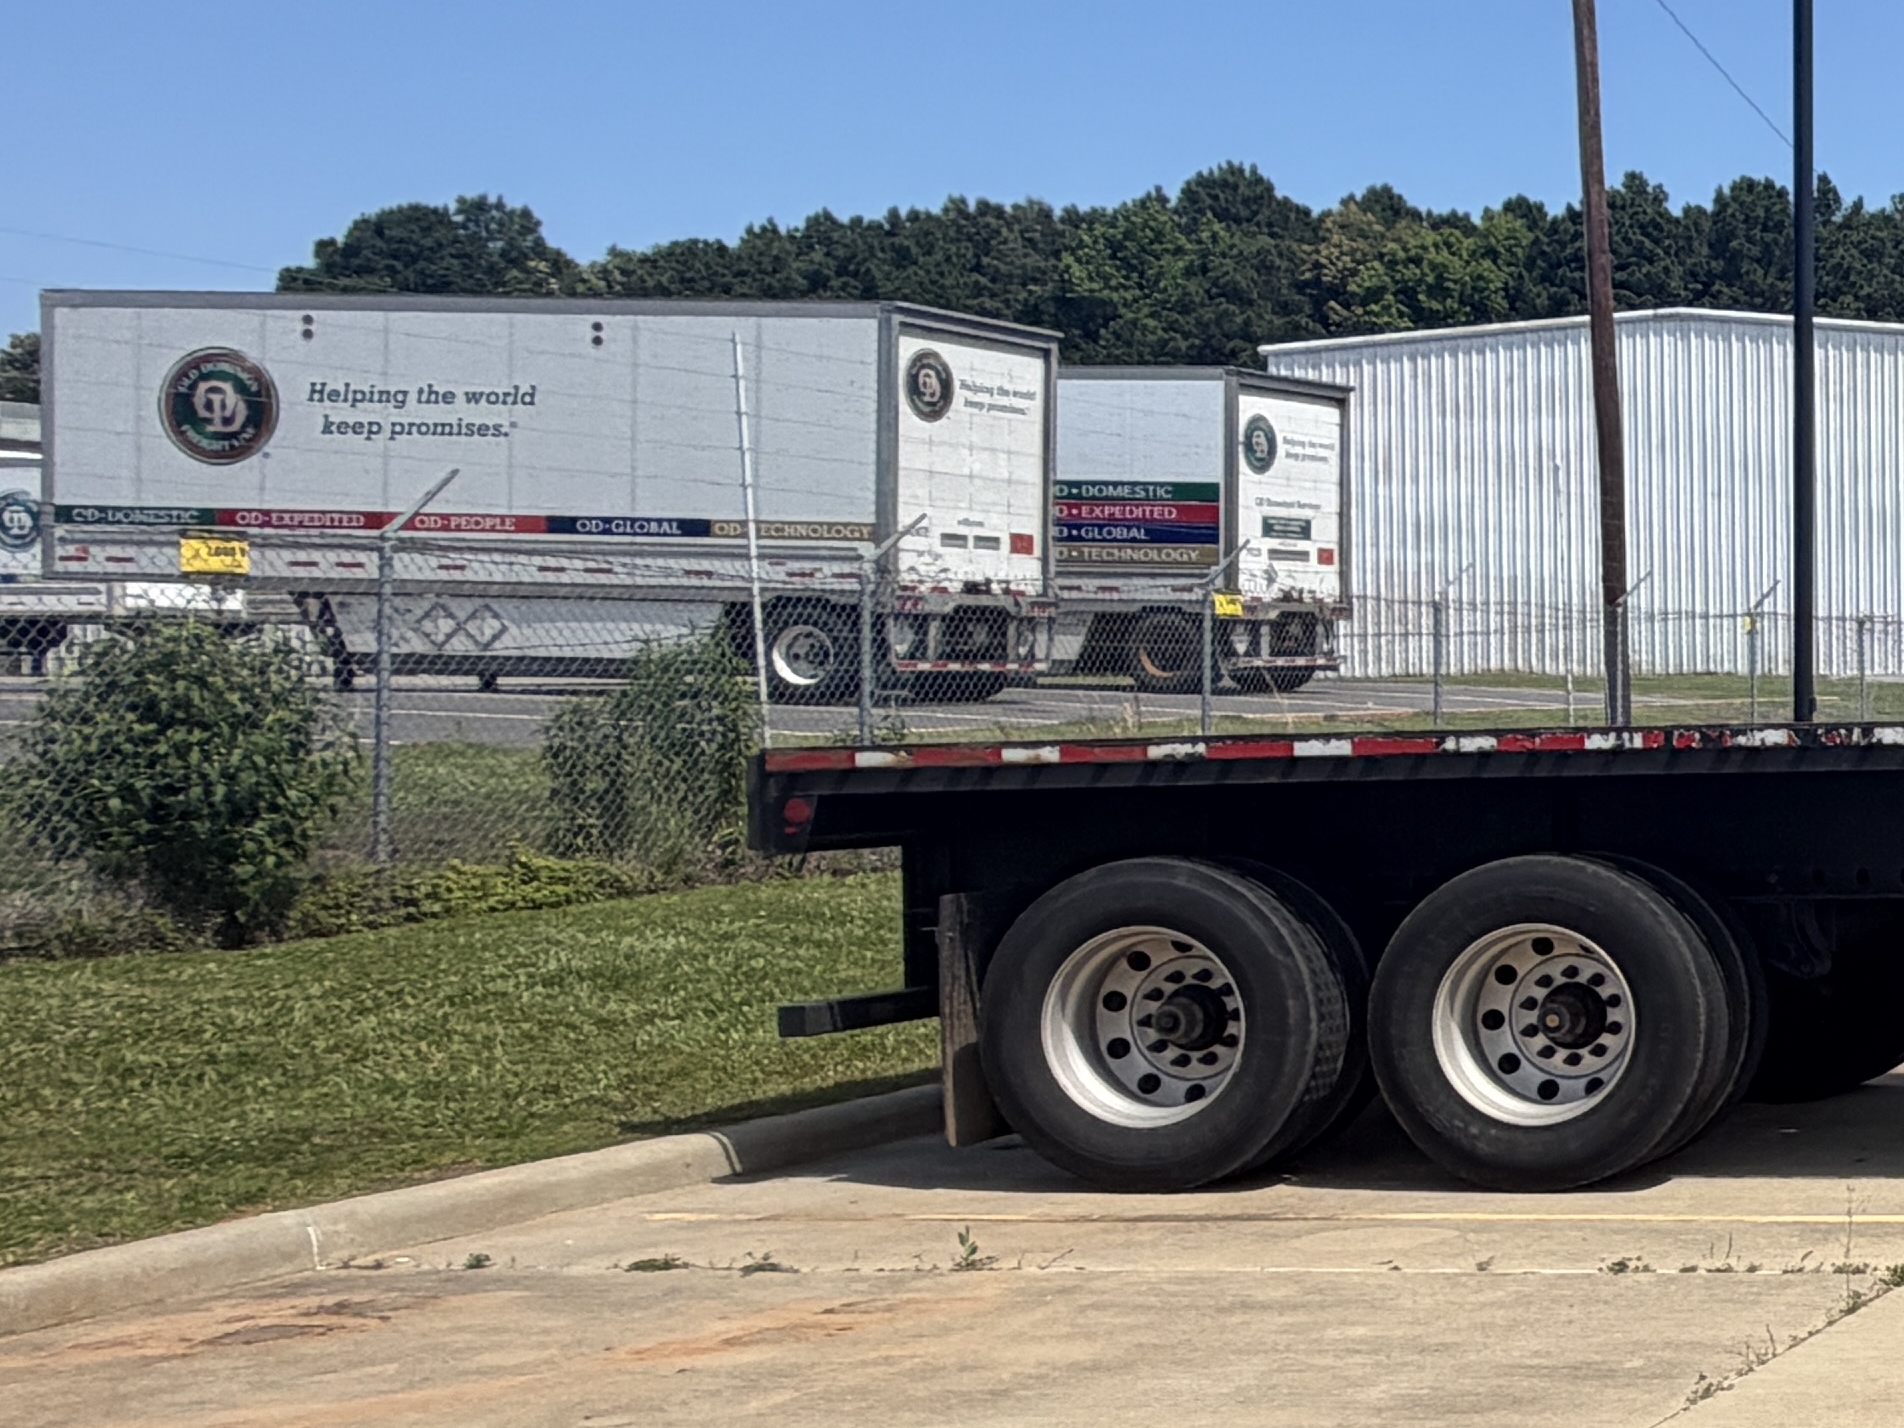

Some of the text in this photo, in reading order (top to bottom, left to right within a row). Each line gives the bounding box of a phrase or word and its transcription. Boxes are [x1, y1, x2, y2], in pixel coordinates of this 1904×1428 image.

[306, 381, 537, 409] Helping the world
[320, 414, 382, 441] keep
[1081, 484, 1174, 499] DOMESTIC
[1081, 505, 1178, 520] EXPEDITED
[1080, 525, 1151, 540] GLOBAL
